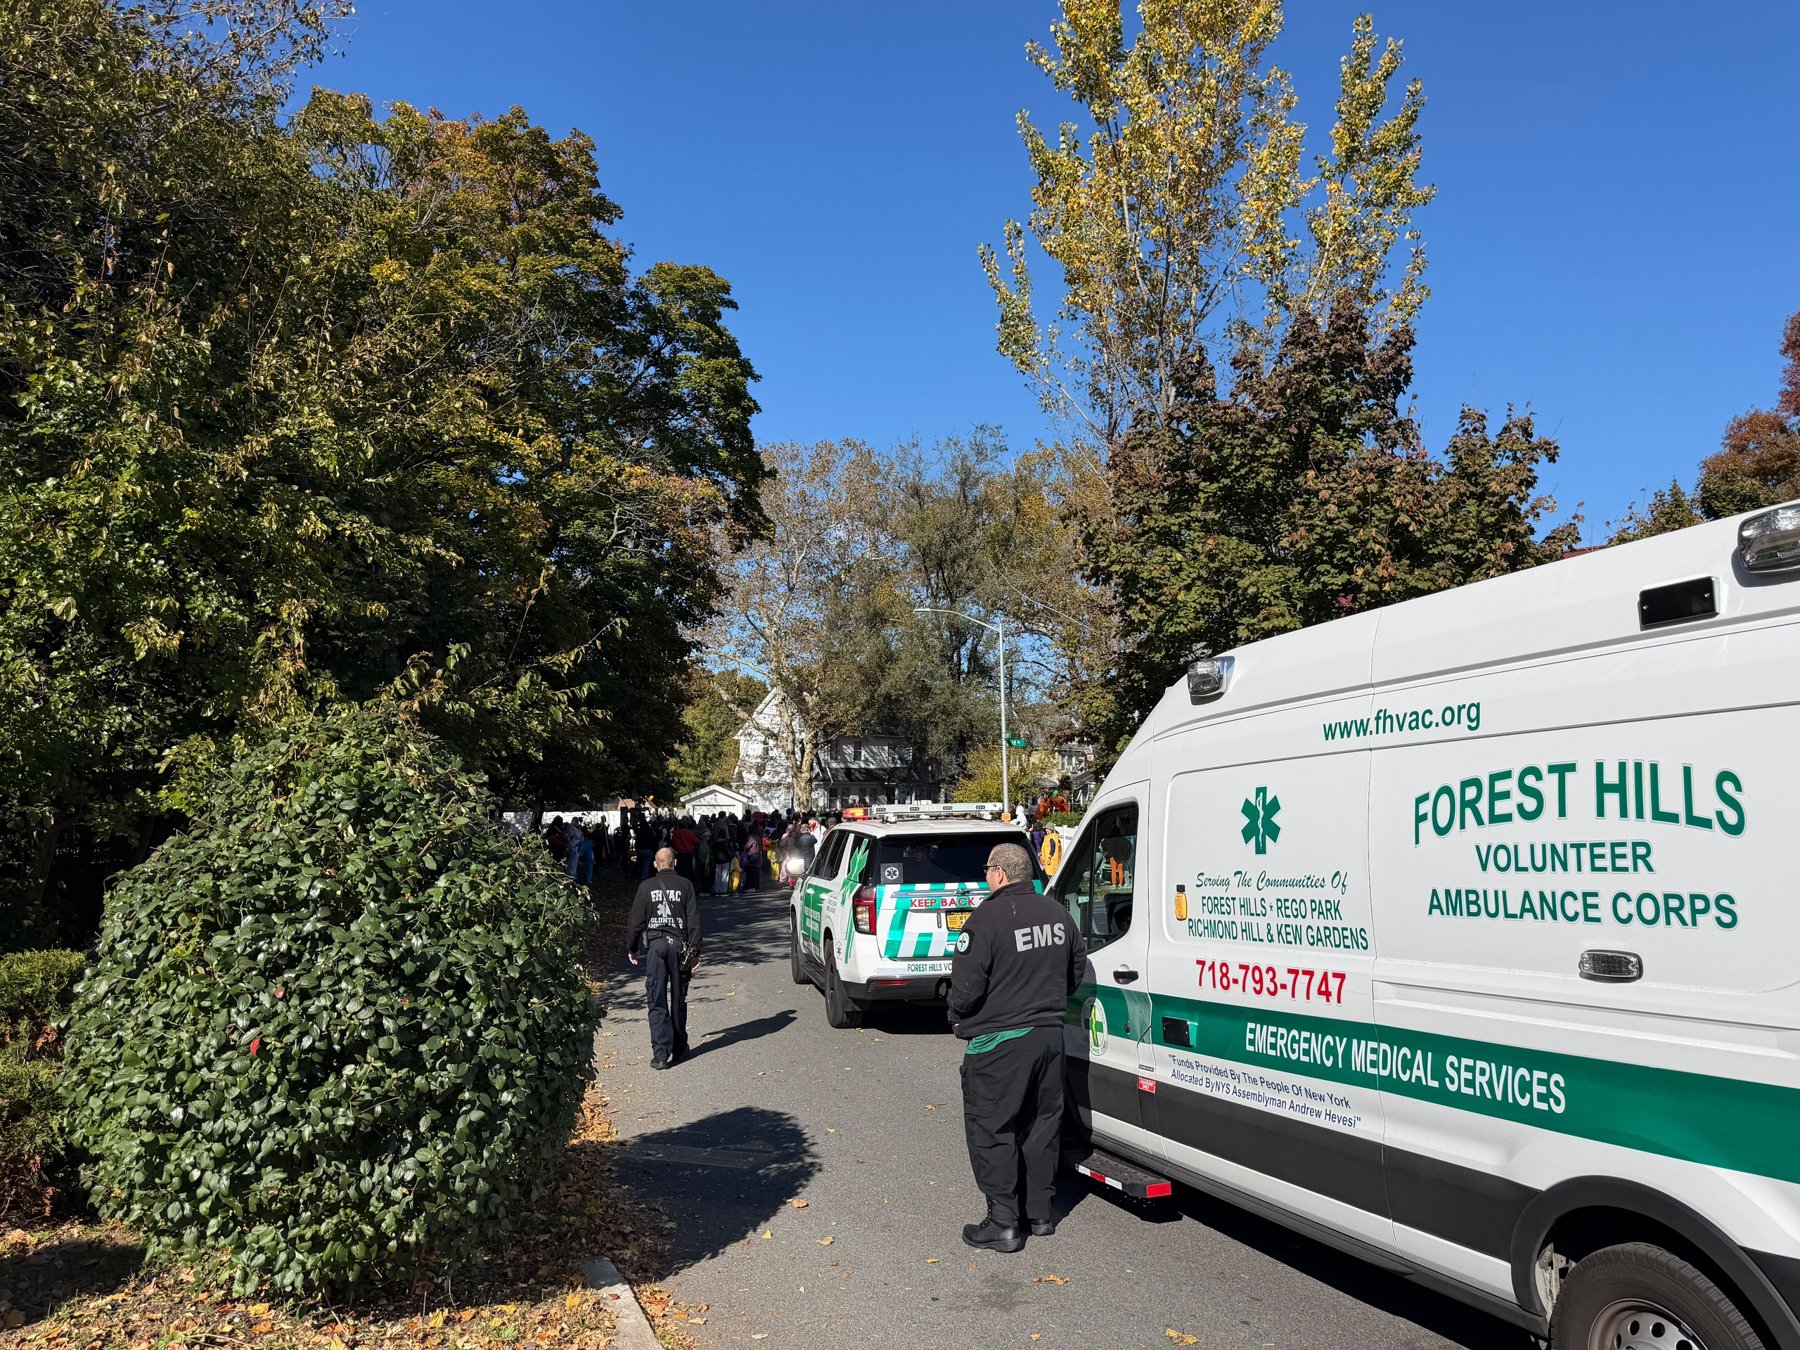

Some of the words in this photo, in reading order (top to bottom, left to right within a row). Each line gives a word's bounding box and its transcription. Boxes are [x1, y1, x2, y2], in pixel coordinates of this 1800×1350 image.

[1323, 702, 1480, 741] www.fhvac.org
[1414, 761, 1578, 847] FOREST
[1595, 760, 1746, 837] HILLS
[1475, 841, 1655, 873] VOLUNTEER
[1195, 872, 1231, 892] Serving
[1233, 870, 1252, 888] The
[1256, 870, 1326, 891] Communities
[1331, 870, 1348, 895] Of
[910, 898, 937, 907] KEEP
[941, 896, 975, 907] BACK
[1201, 896, 1236, 916] FOREST
[1240, 897, 1267, 918] HILLS
[1276, 898, 1307, 919] REGO
[1311, 899, 1343, 921] PARK
[1428, 888, 1602, 923] AMBULANCE
[1612, 891, 1738, 929] CORPS
[1014, 922, 1066, 952] EMS
[1188, 918, 1238, 940] RICHMOND
[1241, 921, 1264, 943] HILL
[1266, 923, 1275, 944] &
[1276, 923, 1303, 945] KEW
[1306, 925, 1369, 951] GARDENS
[907, 963, 928, 972] FOREST
[928, 963, 943, 972] HILLS
[1195, 959, 1346, 1004] 718-793-7747
[1195, 1059, 1229, 1079] Provided
[1230, 1068, 1241, 1083] By
[1241, 1072, 1258, 1086] The
[1260, 1076, 1290, 1094] People
[1291, 1084, 1303, 1097] Of
[1304, 1087, 1326, 1103] New
[1327, 1092, 1352, 1109] York
[1245, 1022, 1347, 1069] EMERGENCY
[1351, 1038, 1439, 1088] MEDICAL
[1445, 1055, 1566, 1114] SERVICES
[1170, 1069, 1203, 1086] Allocated
[1231, 1085, 1287, 1108] Assemblyman
[1288, 1099, 1323, 1118] Andrew
[1324, 1109, 1362, 1129] Hevesi"
